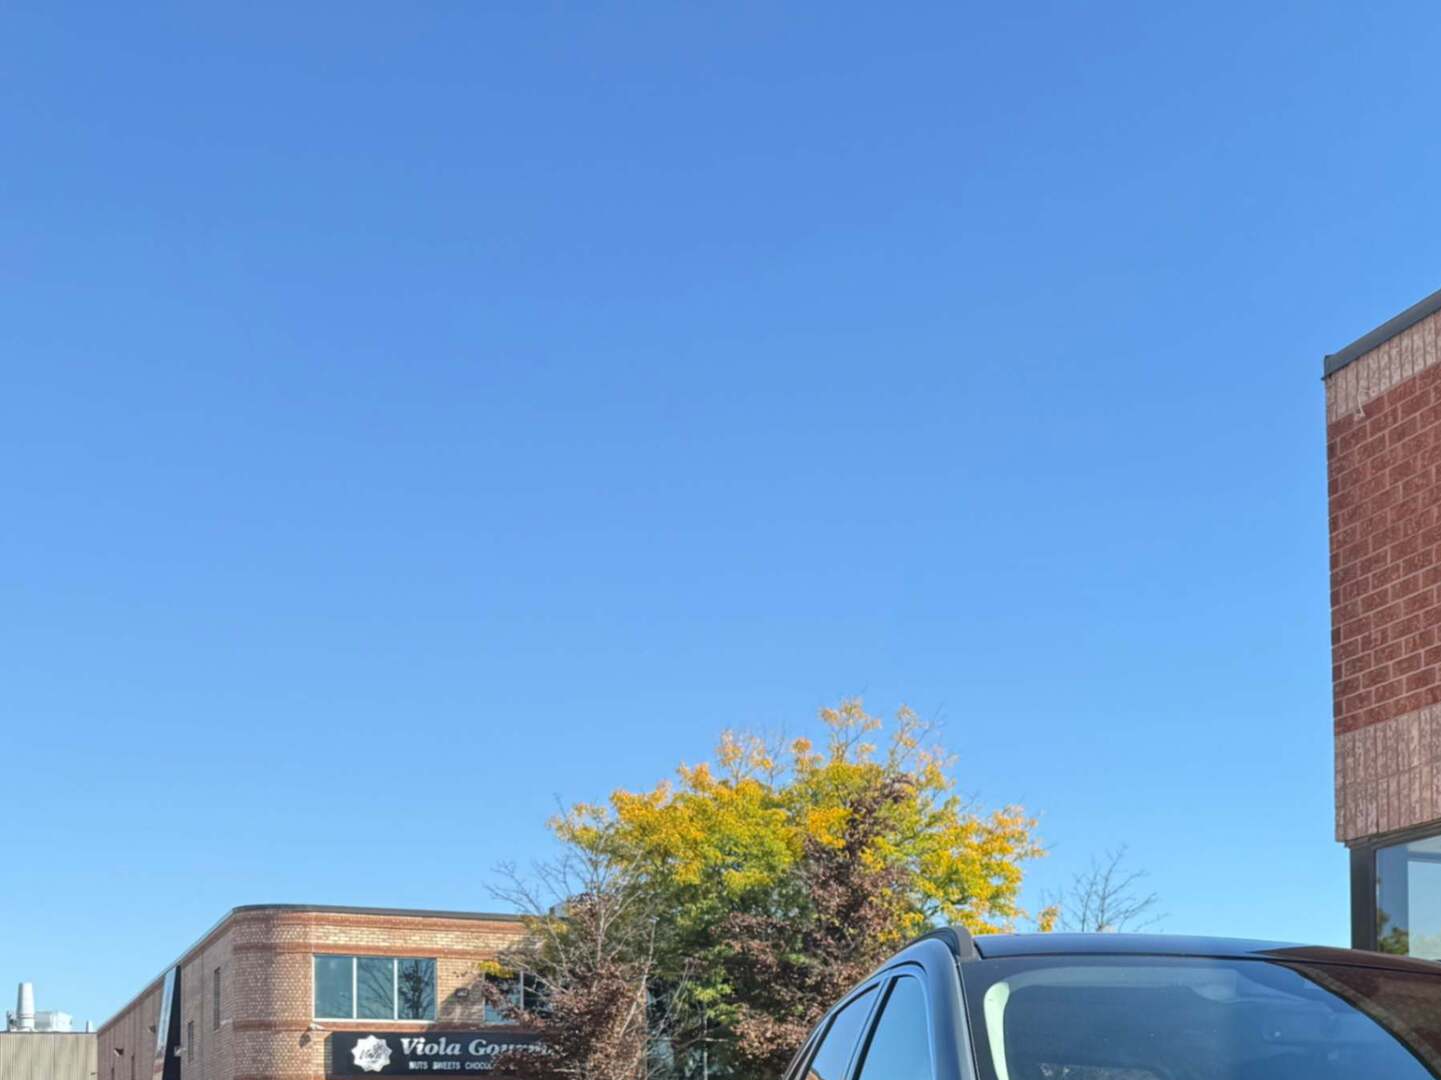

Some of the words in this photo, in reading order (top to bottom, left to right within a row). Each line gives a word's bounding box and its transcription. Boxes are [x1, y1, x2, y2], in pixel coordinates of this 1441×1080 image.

[401, 1037, 461, 1056] Viola
[468, 1038, 560, 1057] Gourm
[408, 1061, 428, 1070] NUTS
[465, 1061, 498, 1071] CHOCOL
